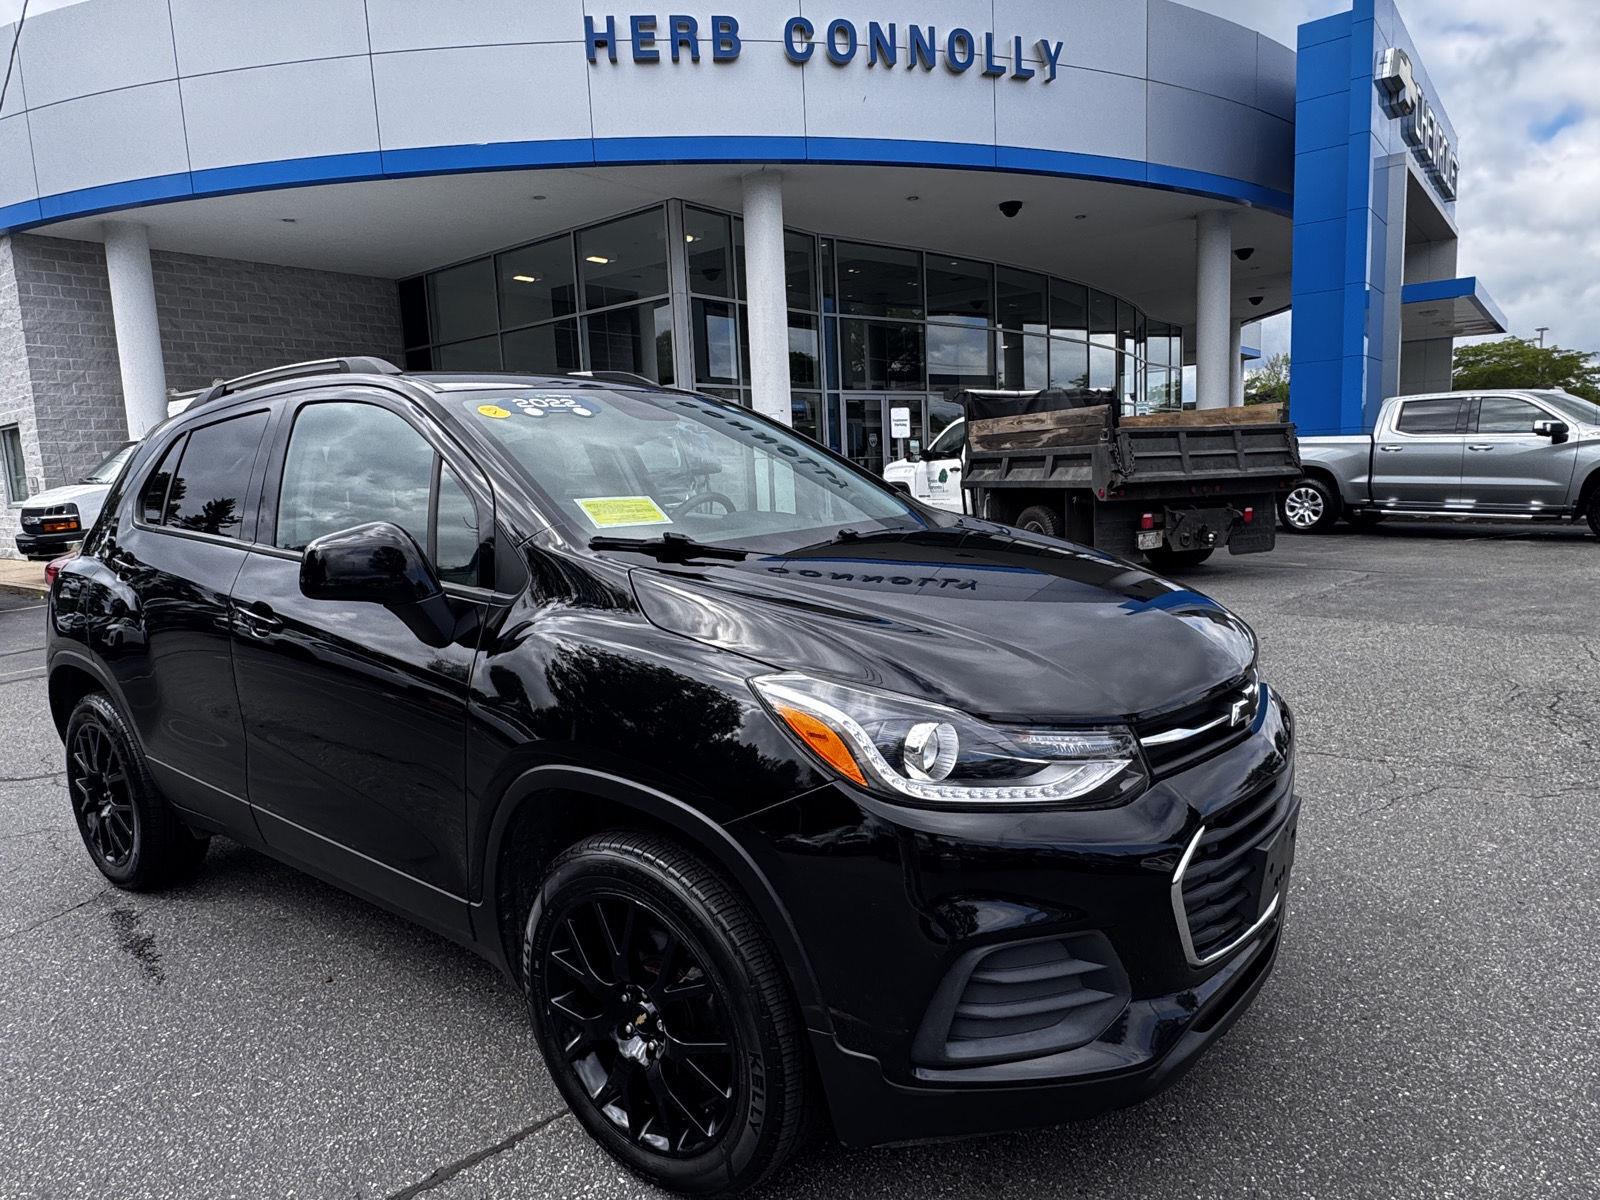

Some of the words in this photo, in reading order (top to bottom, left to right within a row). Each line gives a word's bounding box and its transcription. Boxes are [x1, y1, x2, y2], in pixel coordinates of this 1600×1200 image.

[584, 15, 742, 63] HERB
[784, 17, 1063, 82] CONNOLLY
[1404, 81, 1460, 203] CHEVROLET
[511, 397, 583, 409] 2022
[748, 1051, 765, 1138] KELLY
